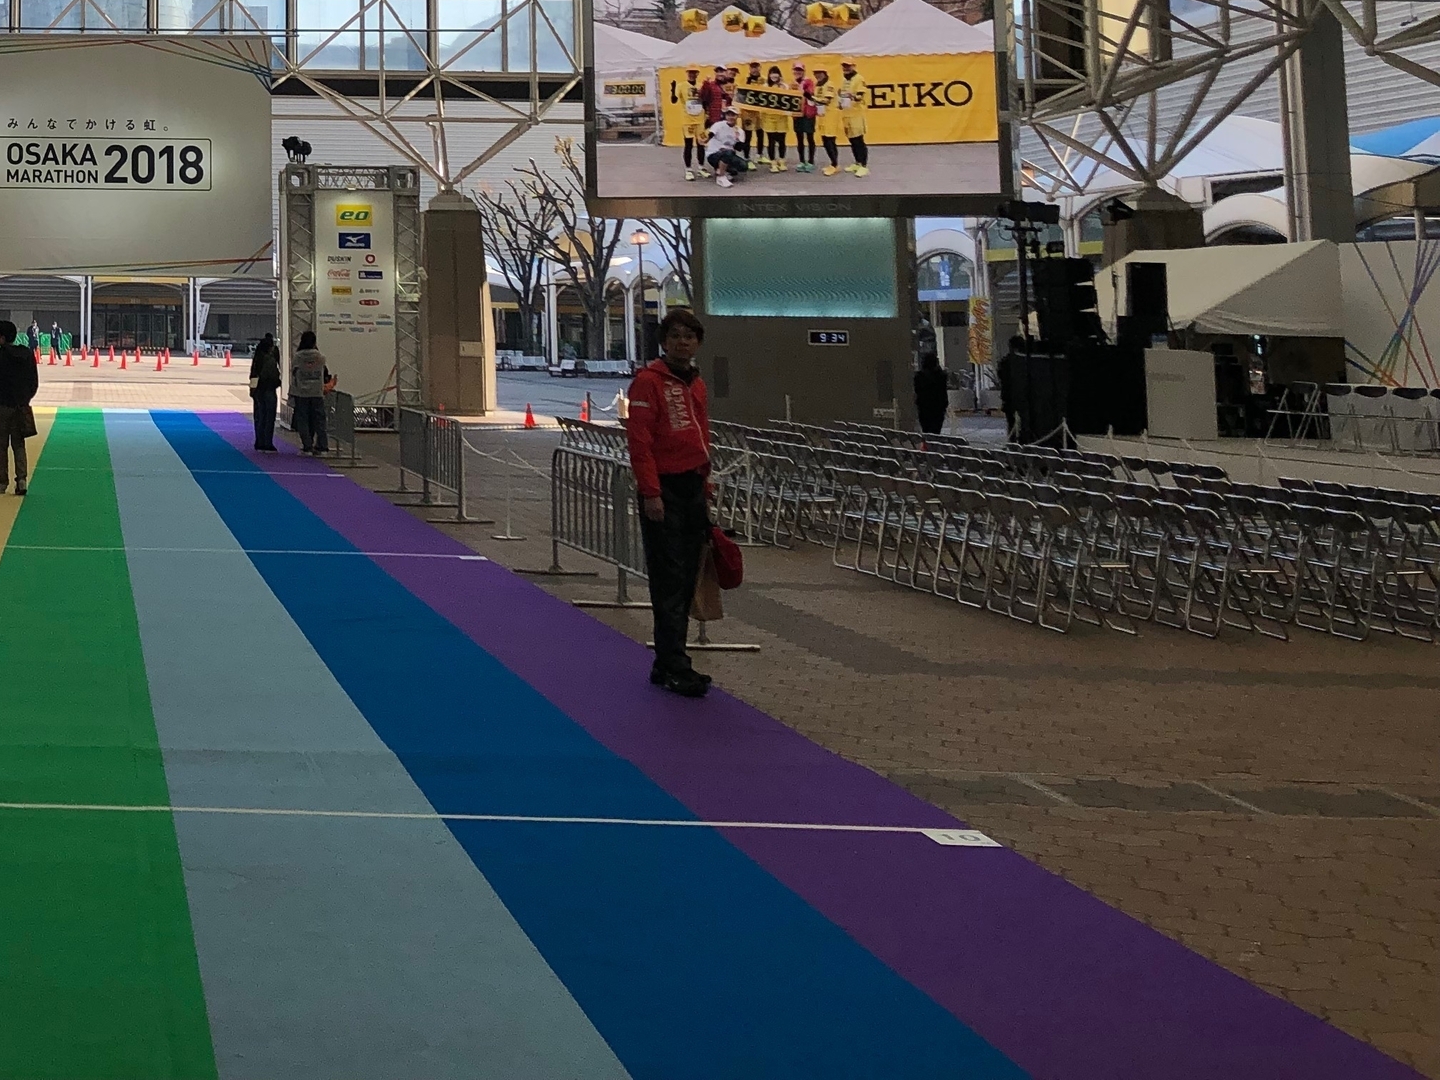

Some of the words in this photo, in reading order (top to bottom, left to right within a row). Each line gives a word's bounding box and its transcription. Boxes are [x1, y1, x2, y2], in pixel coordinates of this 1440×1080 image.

[866, 80, 973, 109] EIKO
[7, 118, 169, 132] みんなでかける虹。
[7, 142, 98, 166] OSAKA
[104, 144, 204, 185] 2018
[6, 169, 99, 184] MARATHON
[340, 211, 369, 220] eo
